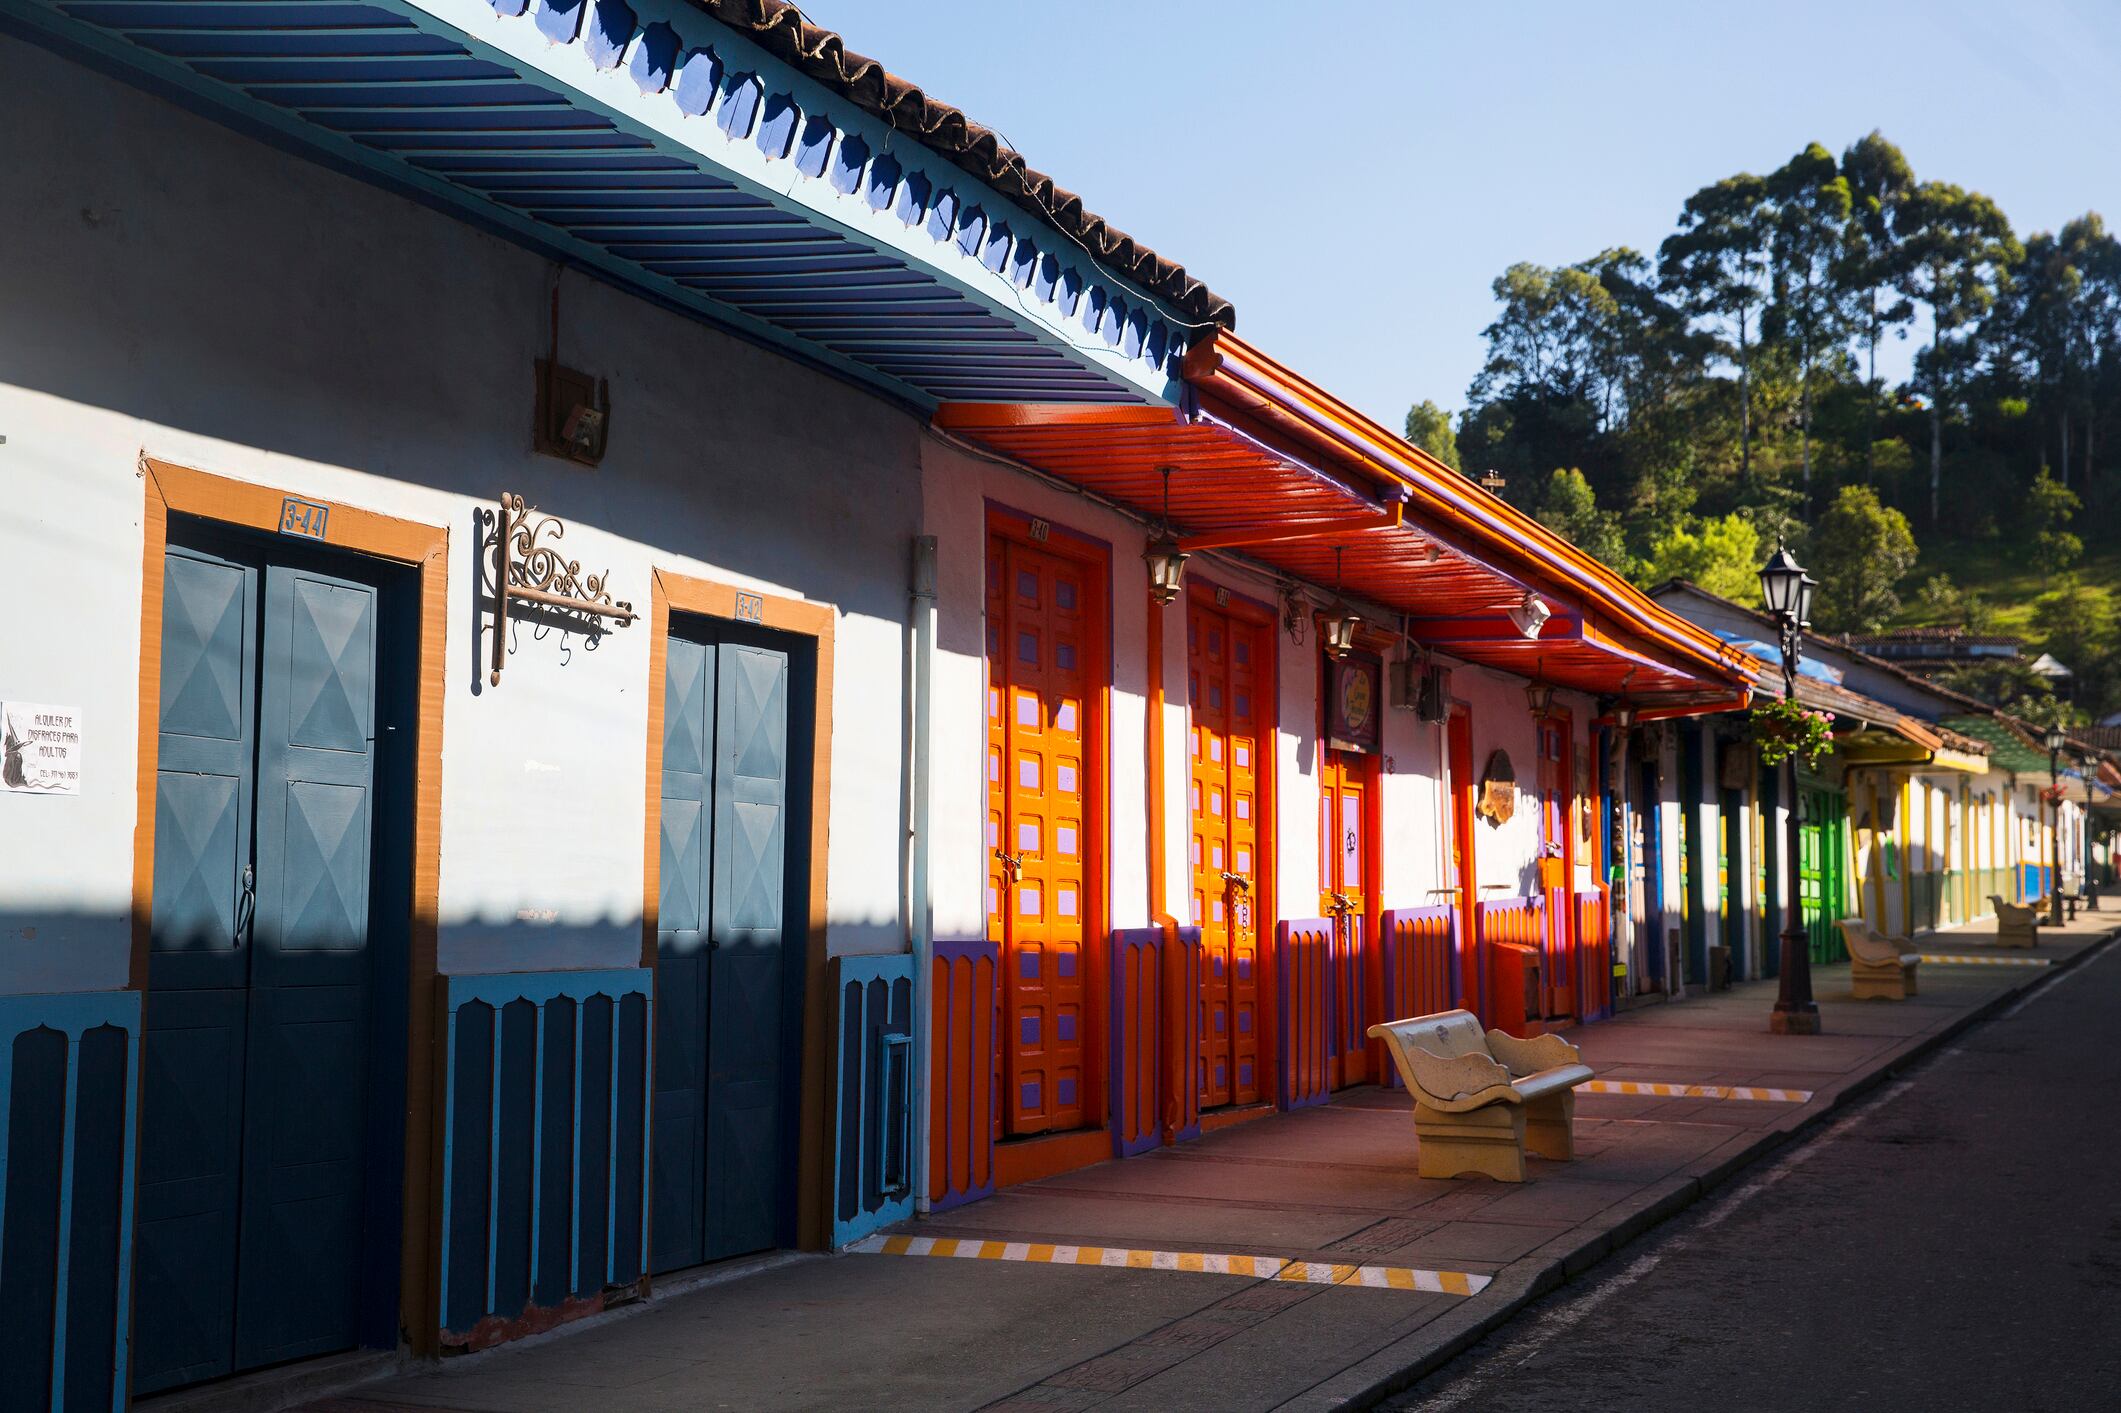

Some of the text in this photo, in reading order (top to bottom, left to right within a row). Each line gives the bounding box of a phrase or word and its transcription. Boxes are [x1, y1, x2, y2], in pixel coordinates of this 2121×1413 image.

[286, 504, 323, 536] 3-44
[739, 596, 760, 620] 3-42
[34, 714, 72, 728] ALQUILER DE
[28, 729, 79, 744] DISFRACES PARA
[39, 746, 67, 759] ADULTOS
